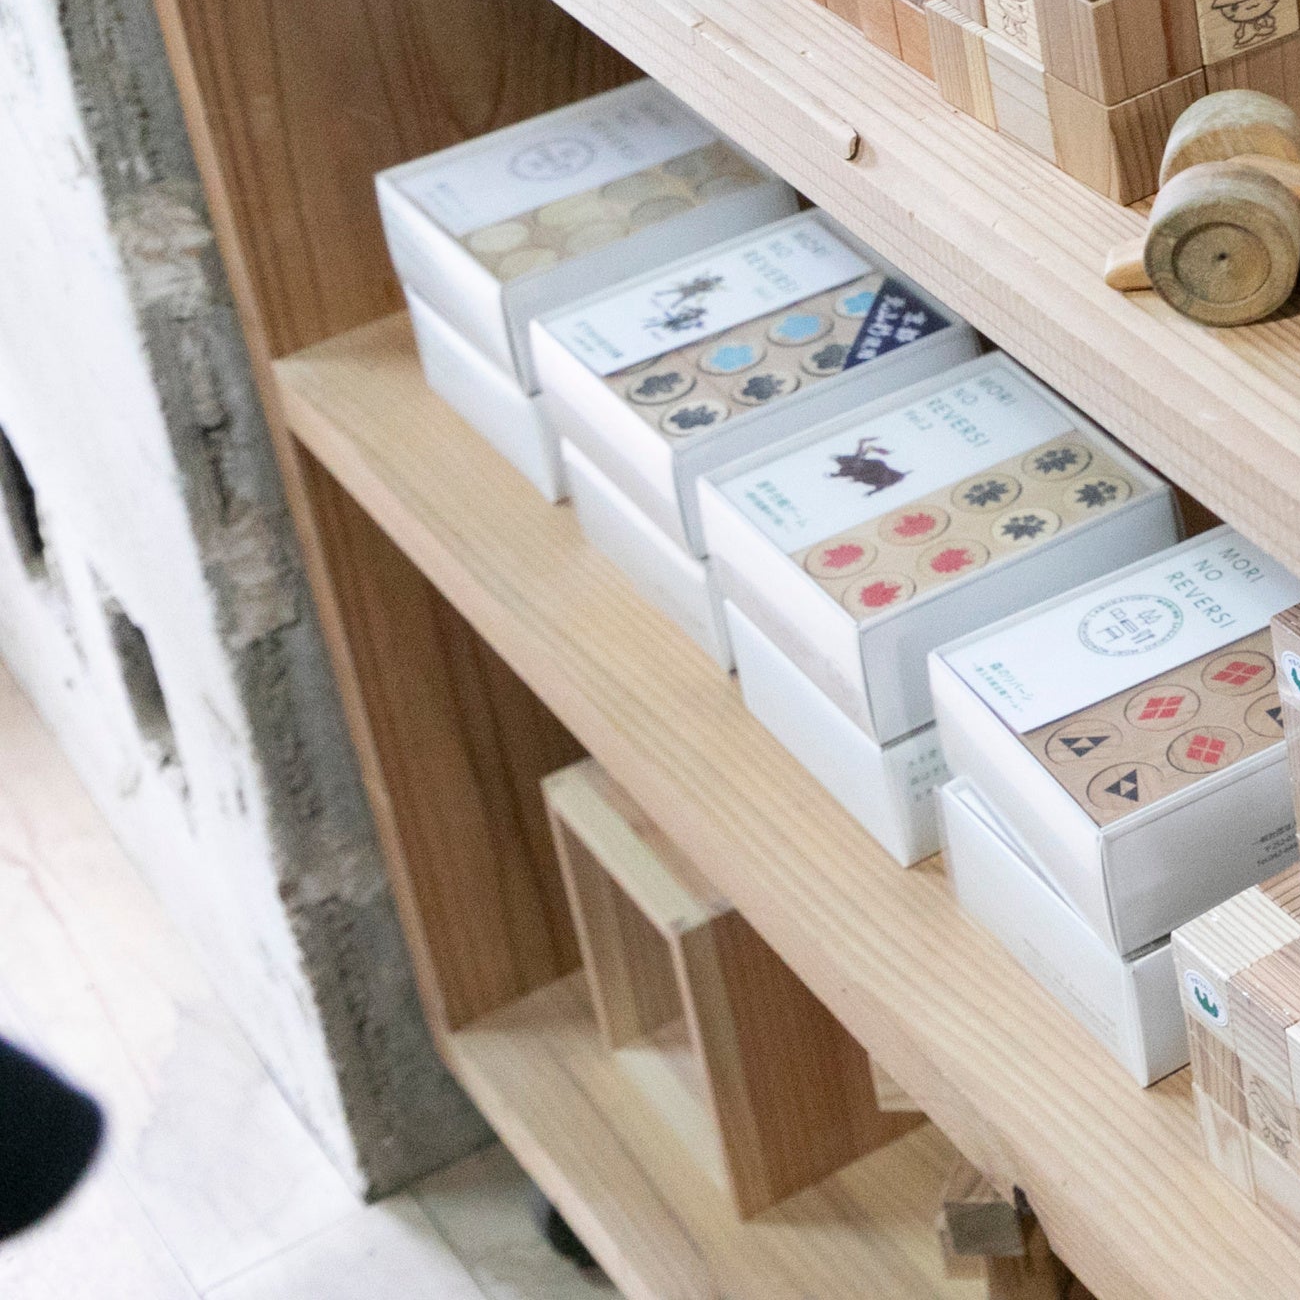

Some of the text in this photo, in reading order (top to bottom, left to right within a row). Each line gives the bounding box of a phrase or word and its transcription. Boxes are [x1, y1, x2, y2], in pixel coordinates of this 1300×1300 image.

[928, 398, 993, 448] REVERSI
[1194, 559, 1224, 582] NO
[1218, 547, 1265, 584] MORI
[1165, 570, 1237, 629] REVERSI
